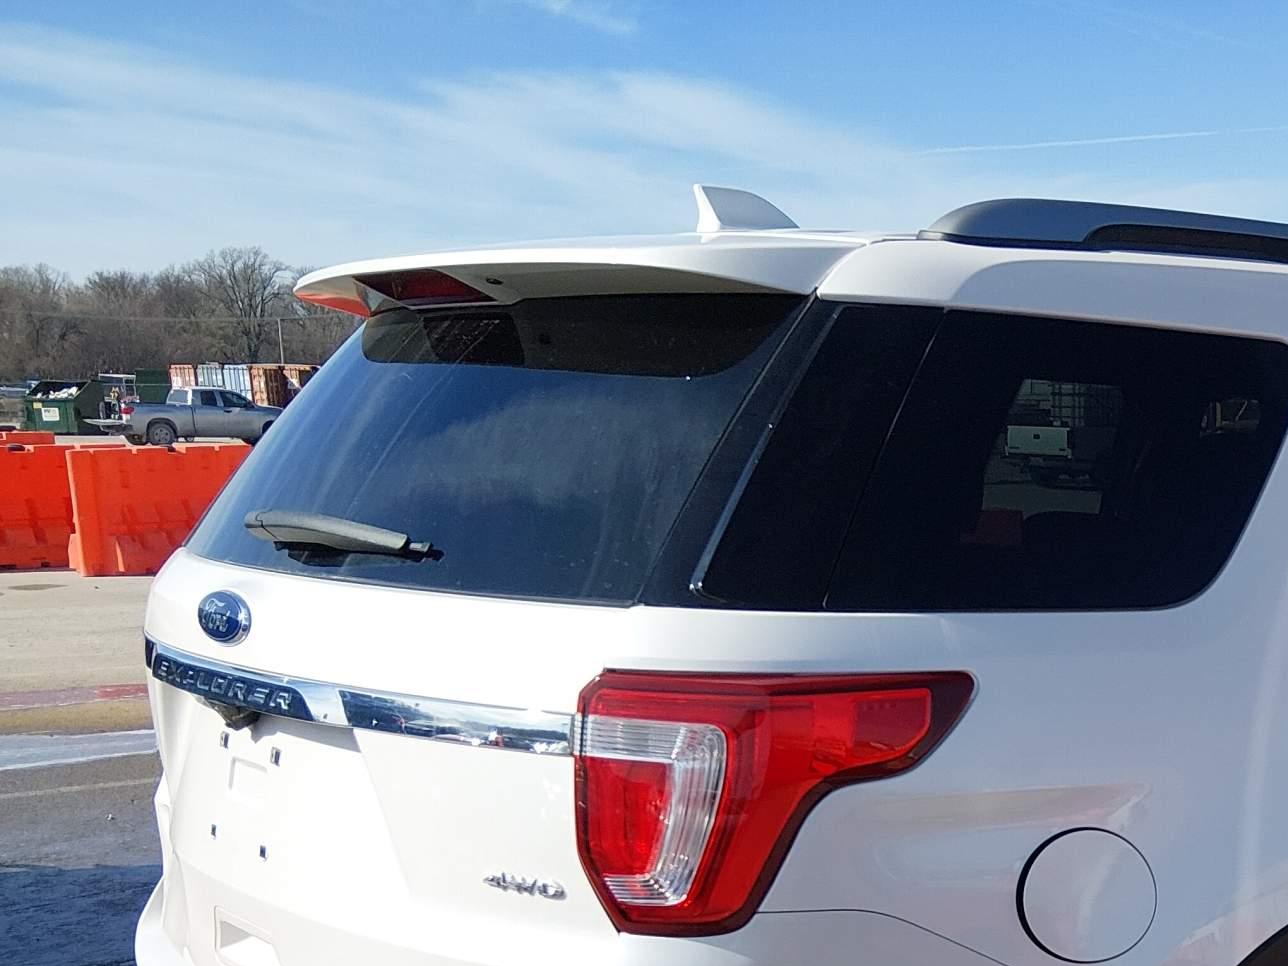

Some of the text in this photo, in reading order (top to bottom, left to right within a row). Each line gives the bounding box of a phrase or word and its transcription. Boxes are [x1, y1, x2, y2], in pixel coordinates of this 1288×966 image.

[202, 597, 231, 633] Ford
[157, 660, 294, 711] EXPLORER
[482, 872, 567, 901] 4WD
